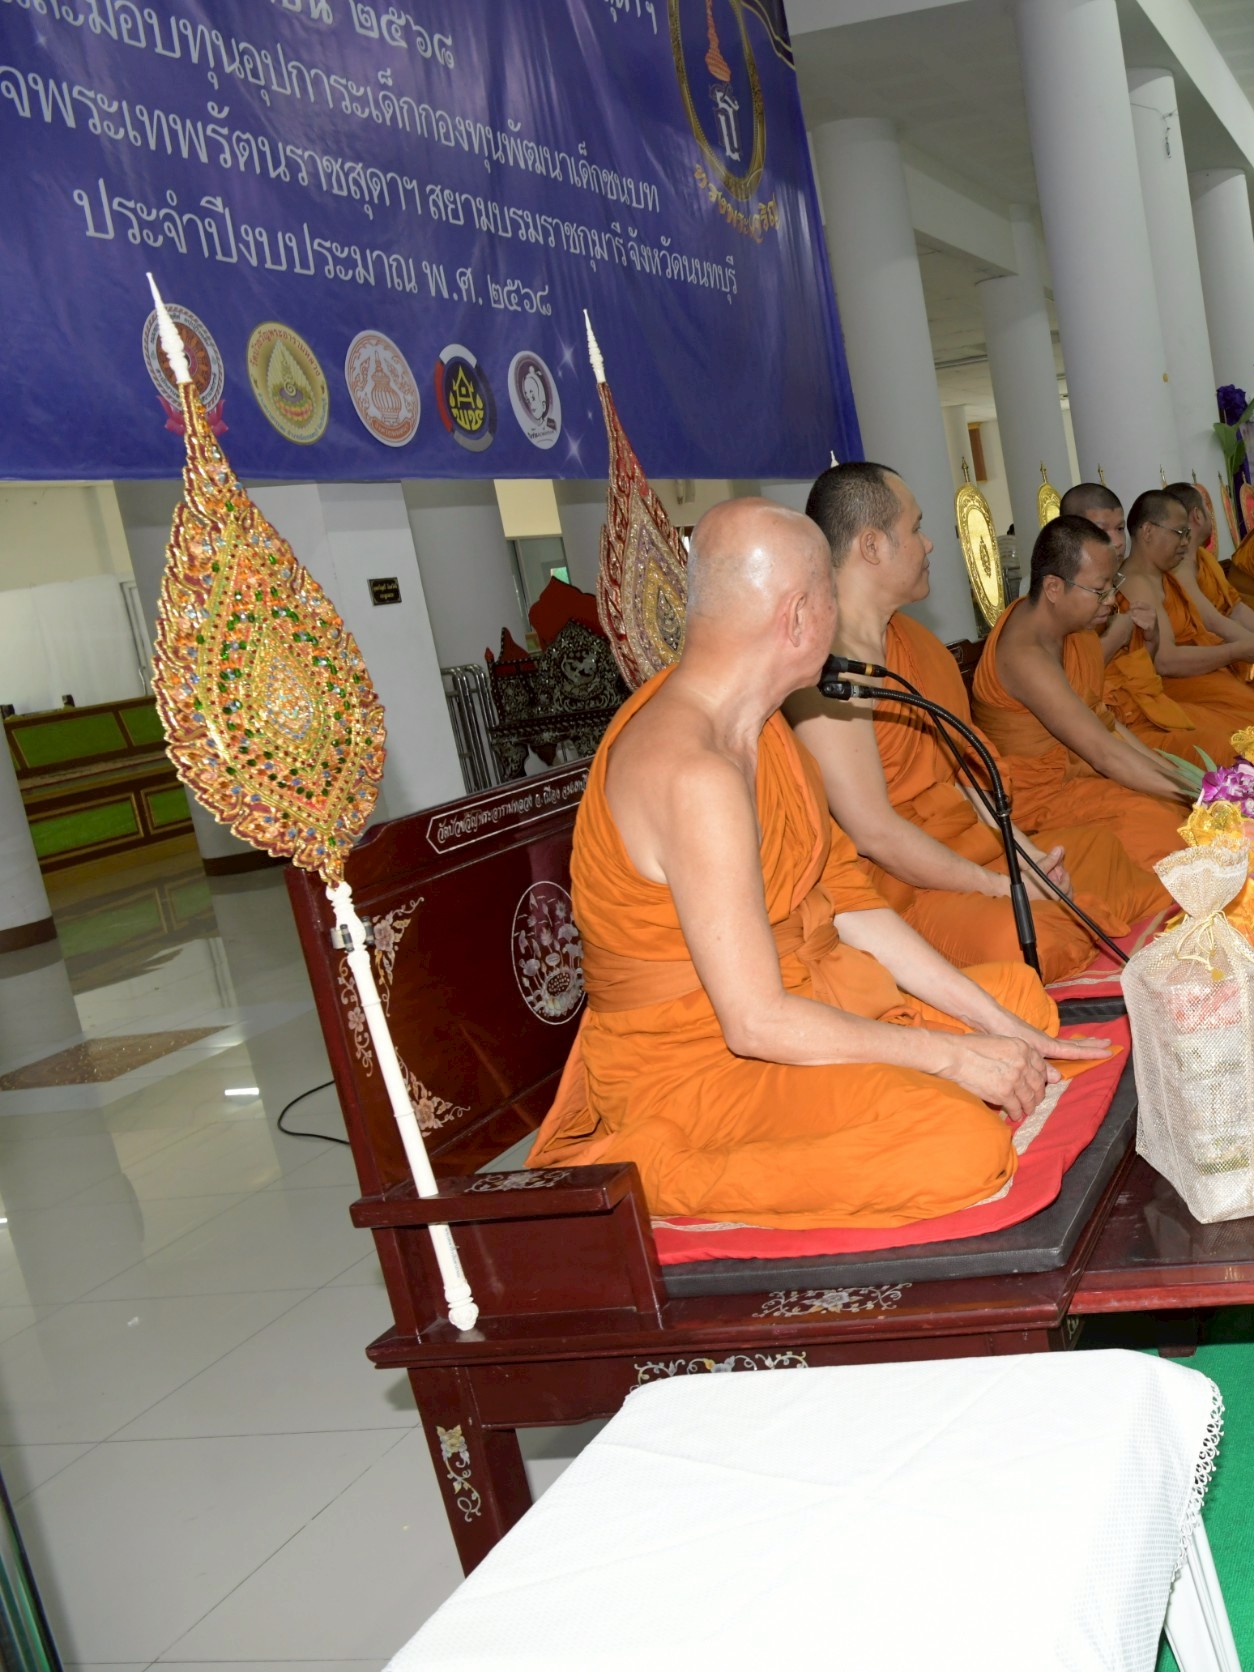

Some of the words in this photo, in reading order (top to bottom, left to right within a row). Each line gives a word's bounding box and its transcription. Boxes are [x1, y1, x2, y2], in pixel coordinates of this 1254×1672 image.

[0, 0, 660, 213] ะมอบทุนอุปการะเด็กกองทุนพัฒนาเด็กชนบท
[73, 178, 418, 294] ประจำปีงบประมาณ
[422, 260, 483, 305] พ.ศ.
[487, 273, 552, 316] ๒๕๖๘
[627, 226, 738, 304] จังหวัดนนทบุรี
